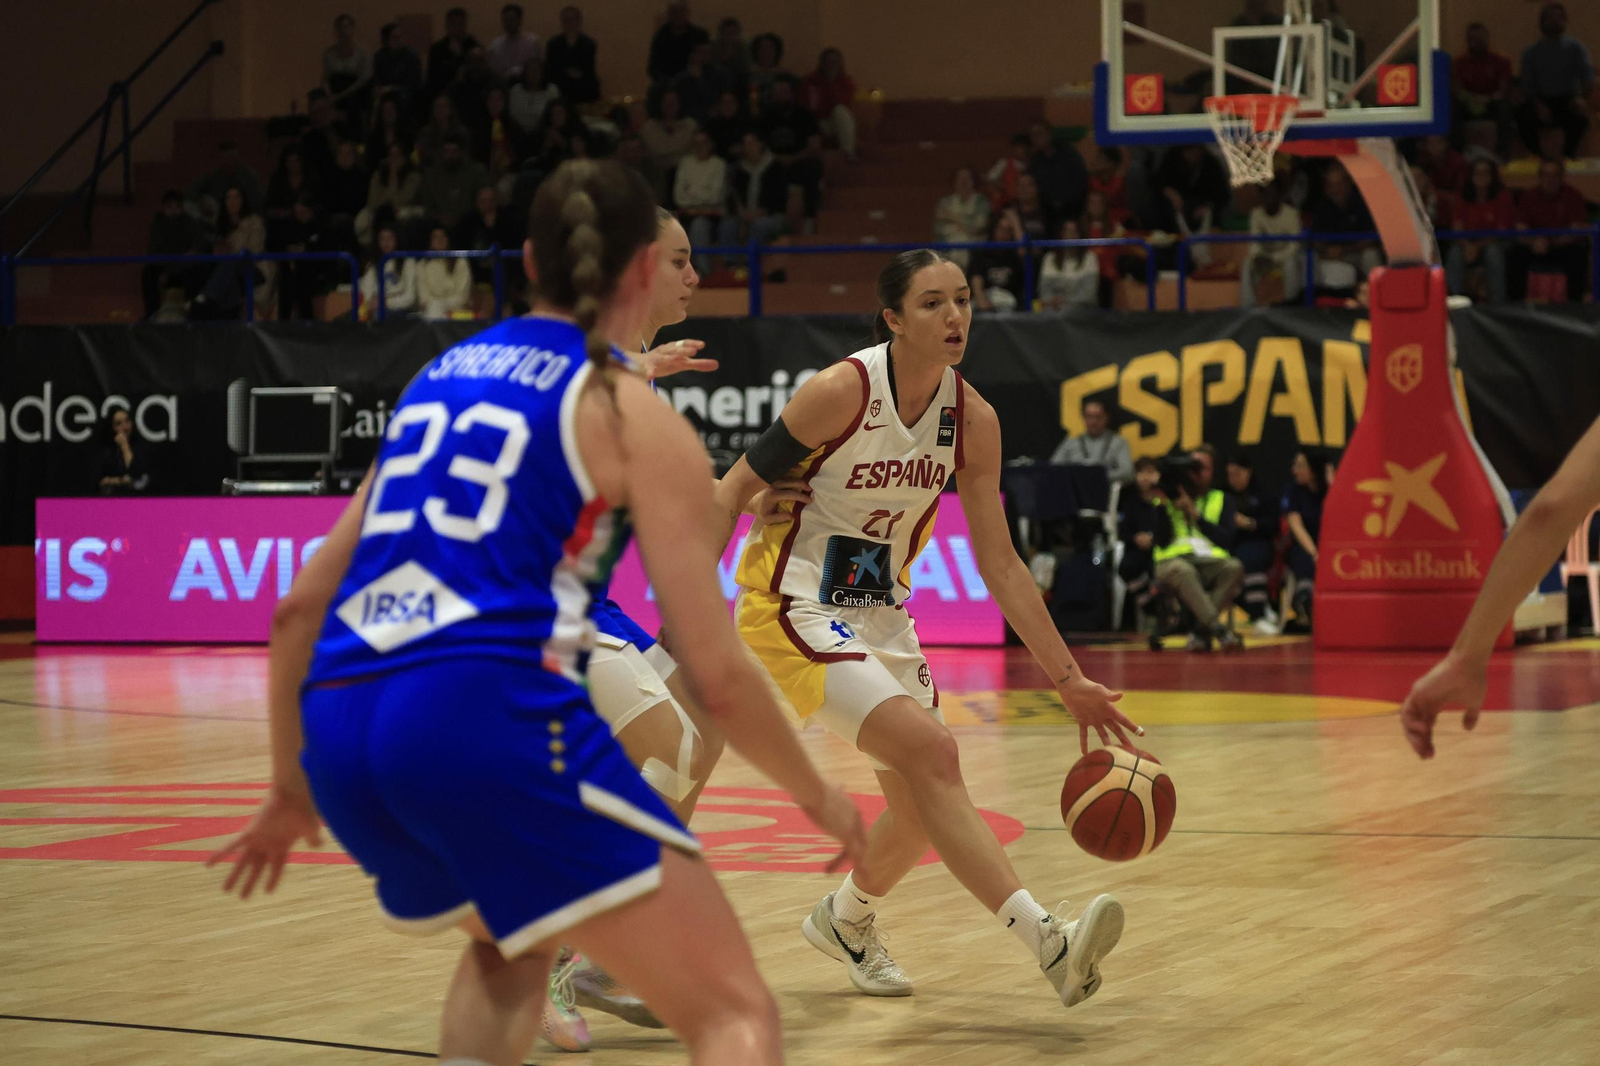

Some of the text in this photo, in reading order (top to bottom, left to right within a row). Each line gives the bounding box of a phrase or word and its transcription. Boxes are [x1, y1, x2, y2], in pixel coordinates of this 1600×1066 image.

[360, 400, 532, 543] 23
[845, 453, 946, 491] ESPAÑA
[861, 509, 906, 539] 21
[1332, 549, 1482, 580] CaixaBank
